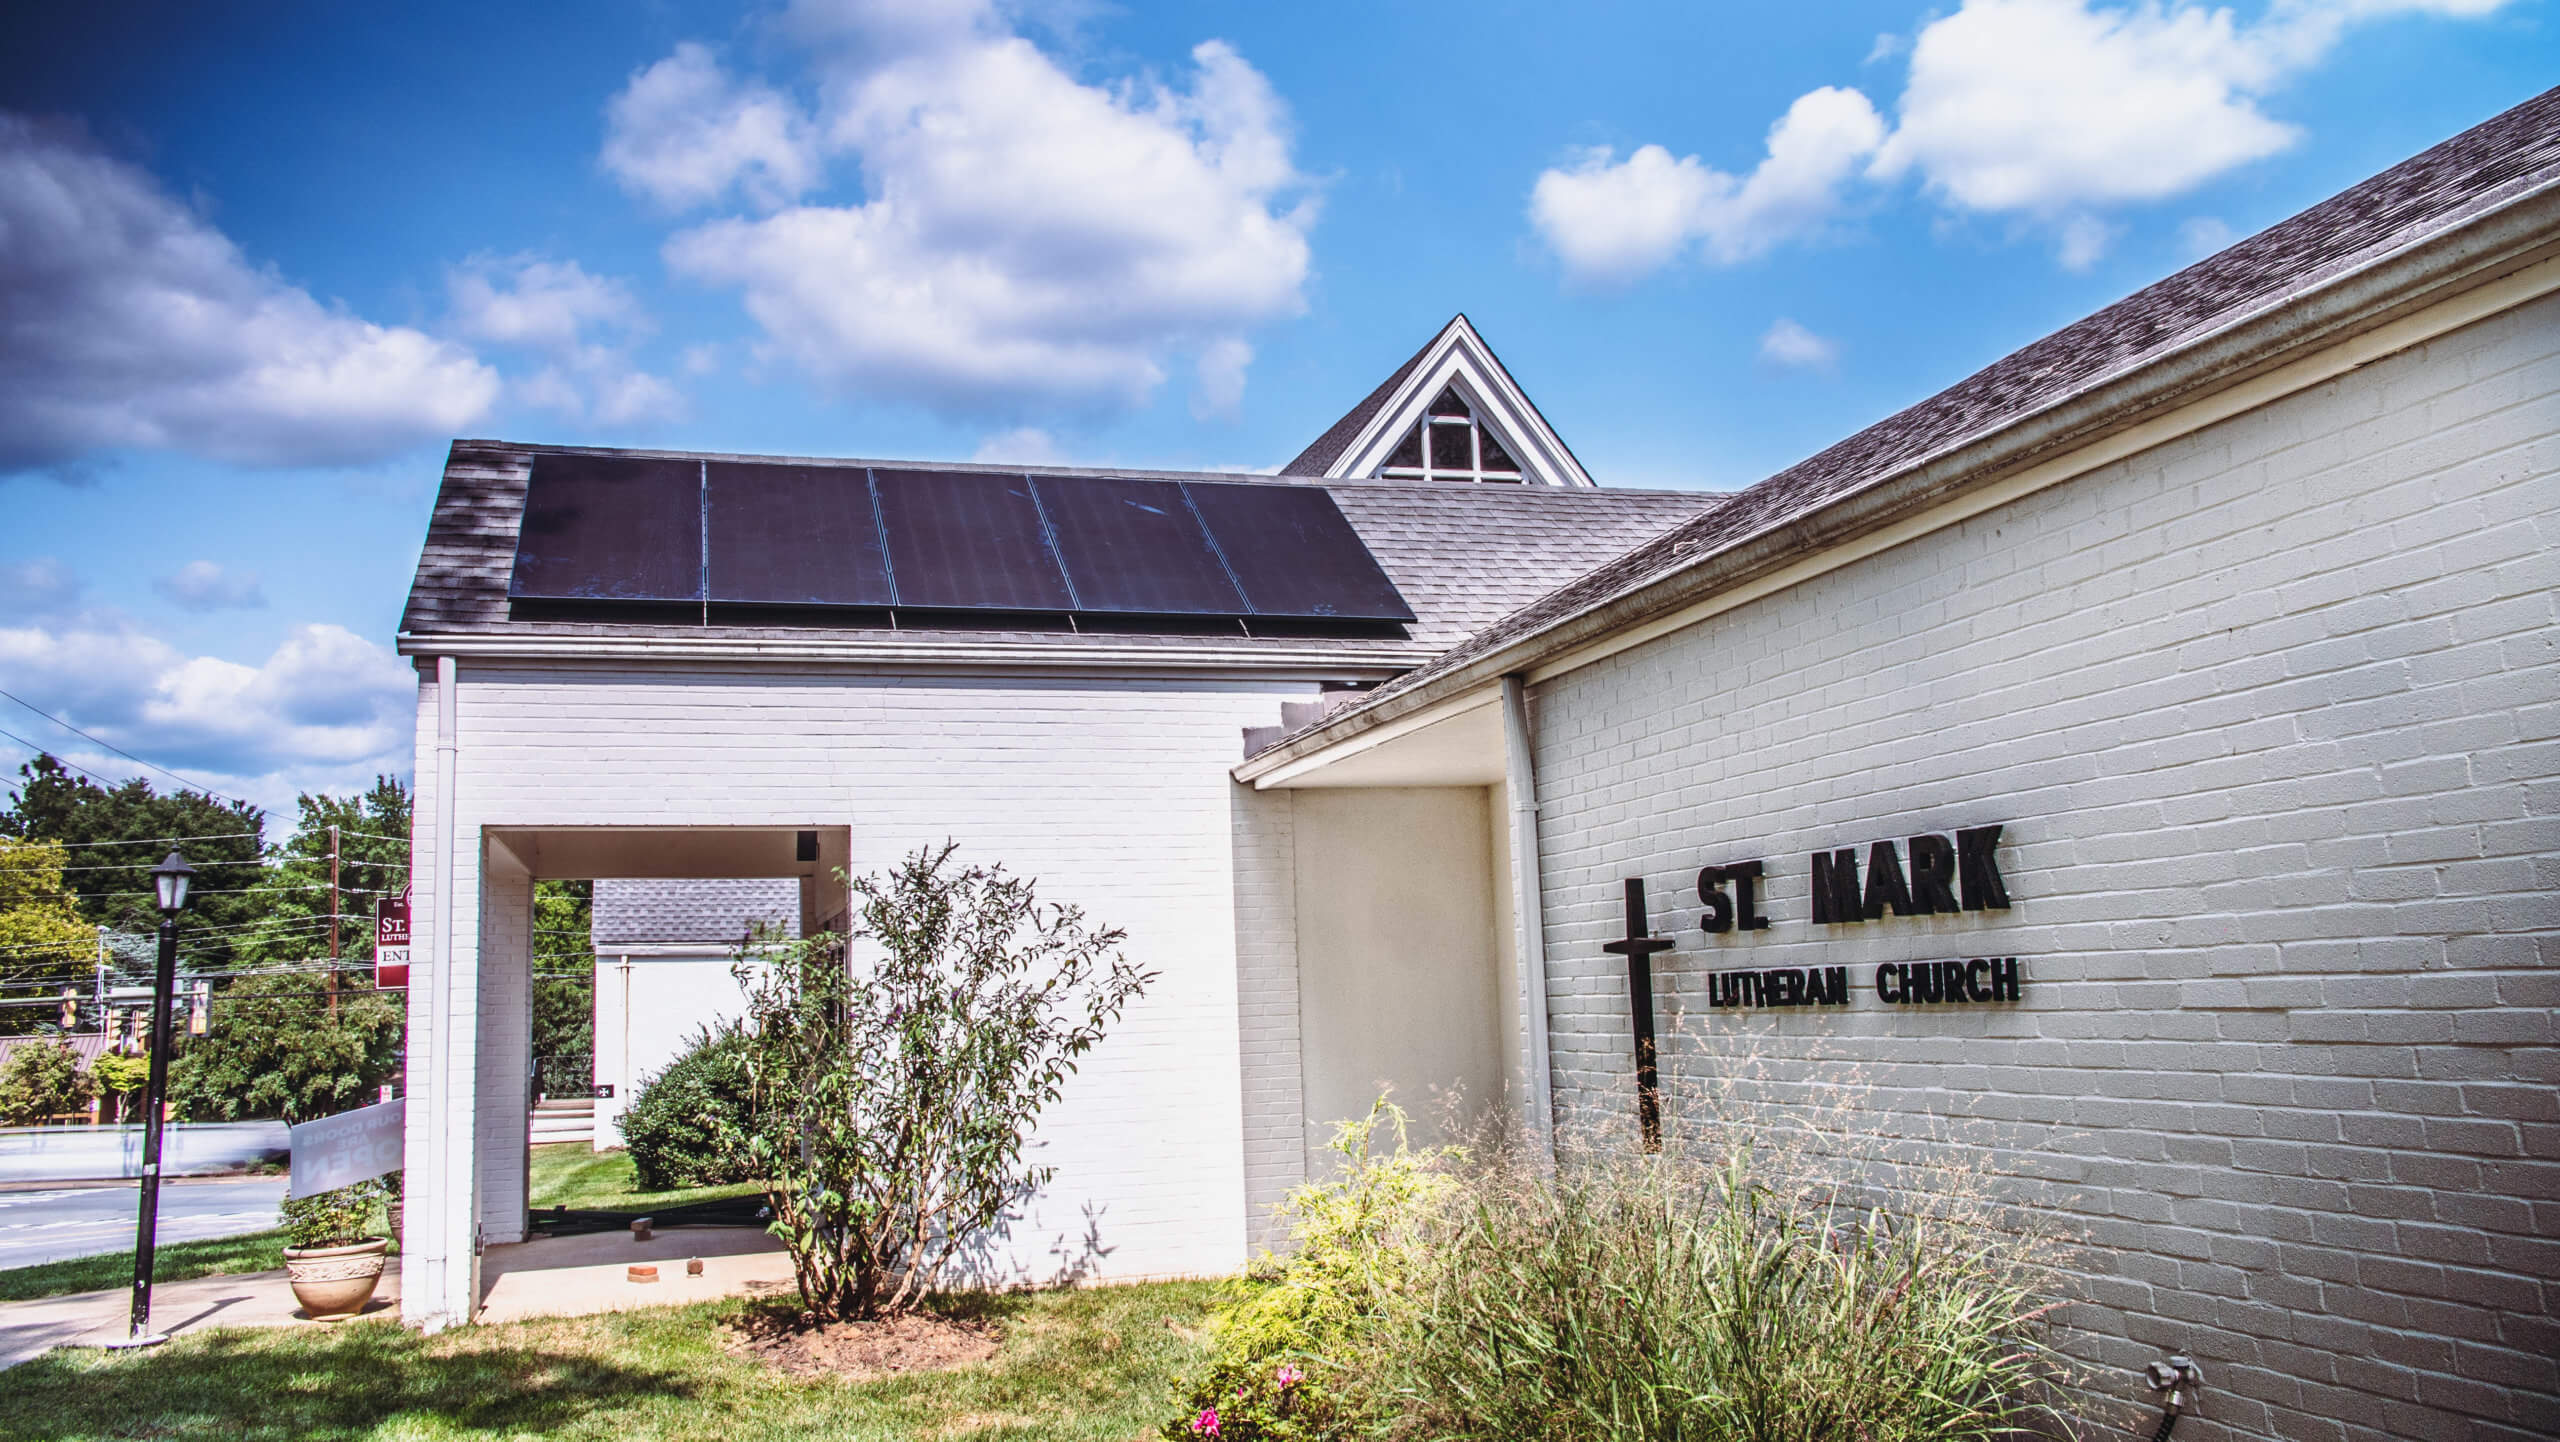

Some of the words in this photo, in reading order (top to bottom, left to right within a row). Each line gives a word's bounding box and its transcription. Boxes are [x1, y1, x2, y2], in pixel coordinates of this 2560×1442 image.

[1697, 860, 1771, 934] ST.
[1811, 825, 2011, 925] MARK
[1708, 966, 1850, 1008] LUTHERAN
[1875, 957, 2021, 1004] CHURCH
